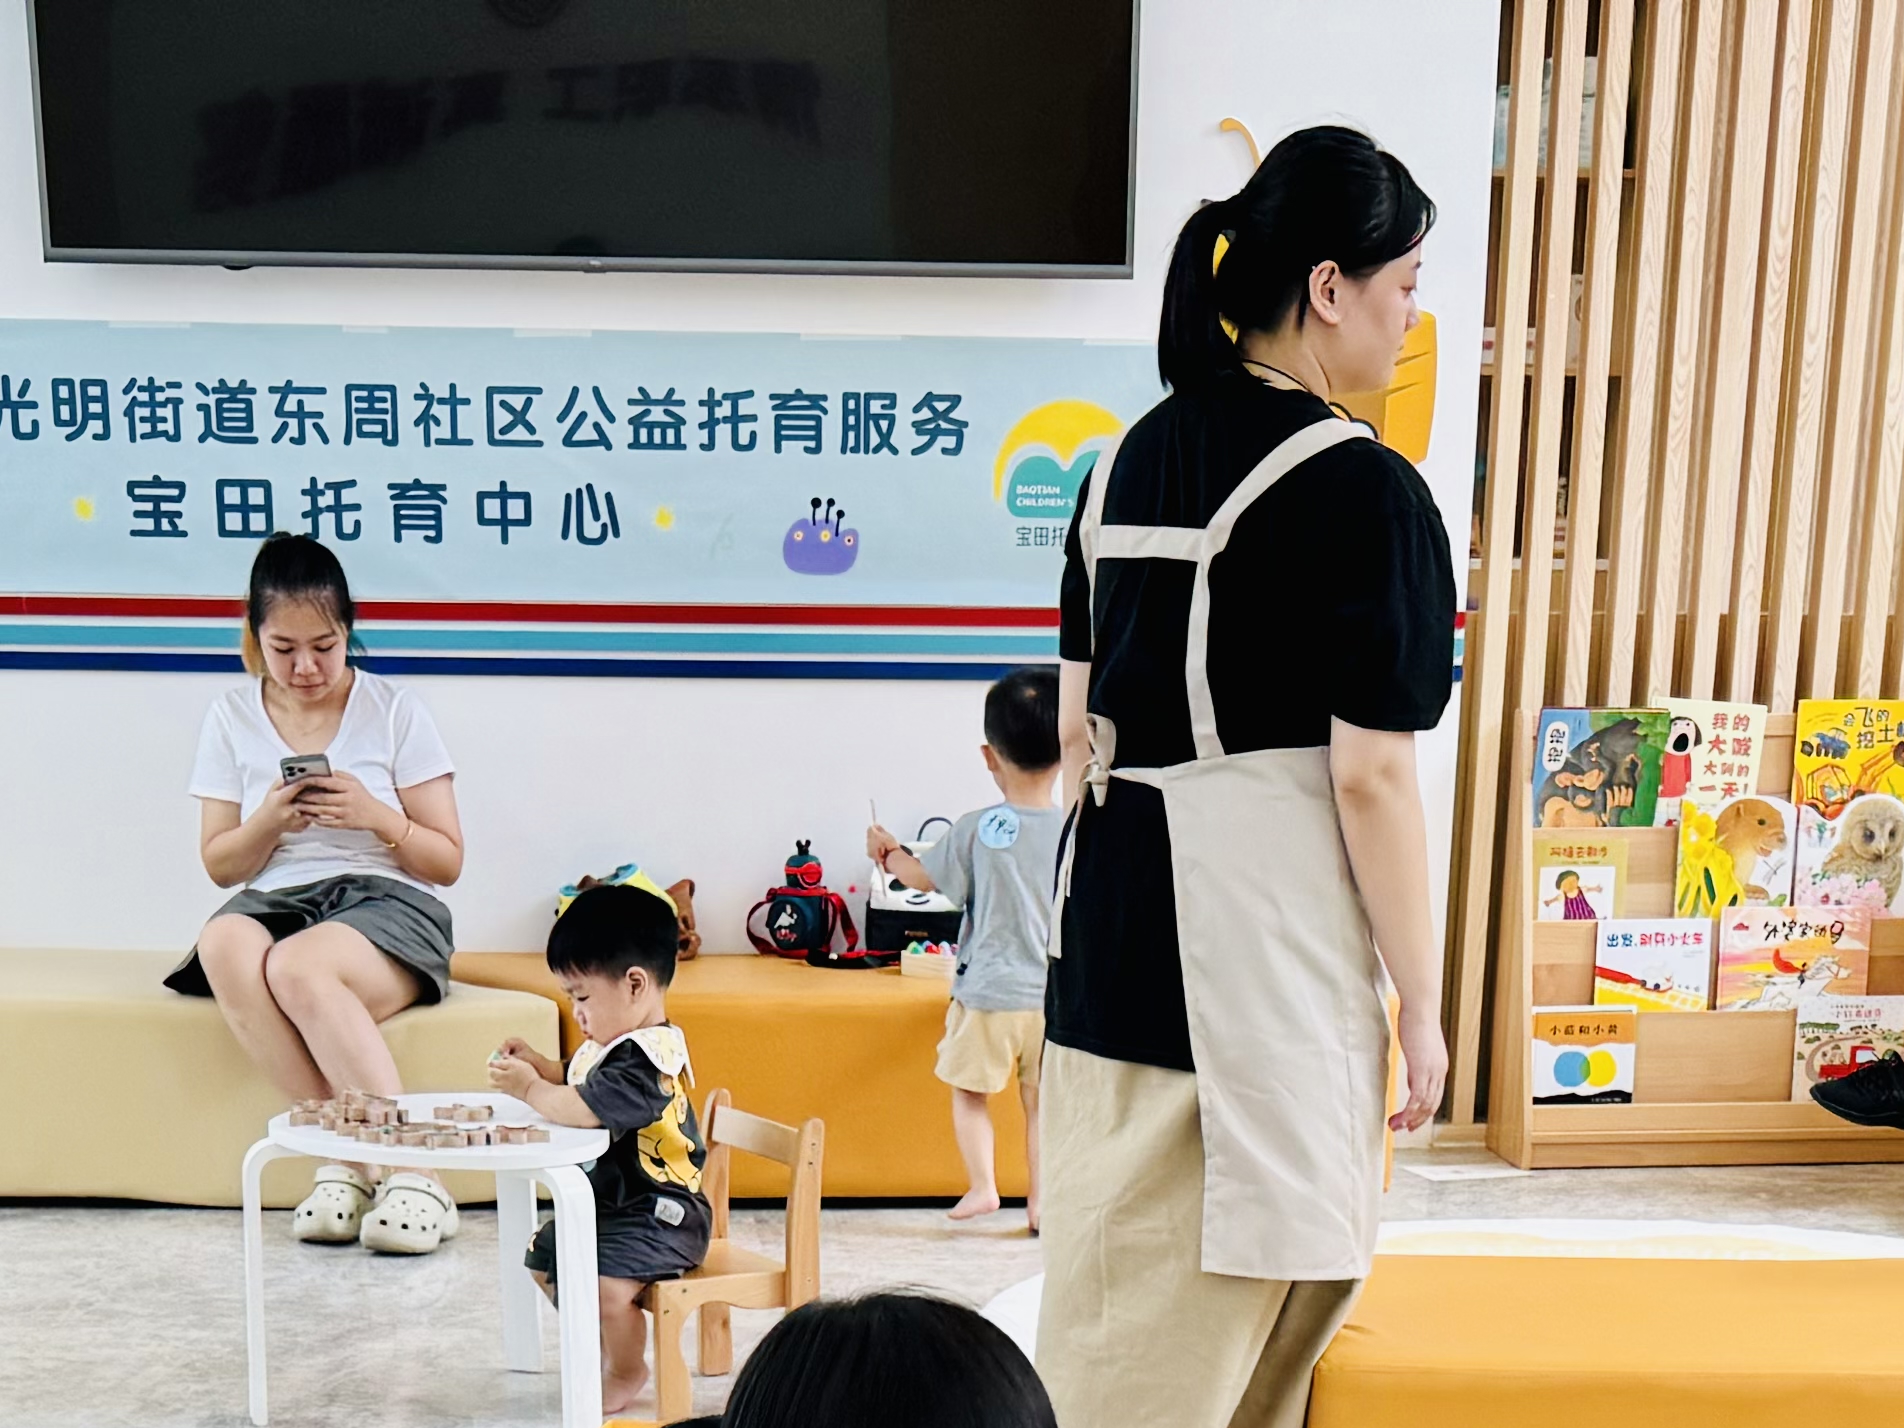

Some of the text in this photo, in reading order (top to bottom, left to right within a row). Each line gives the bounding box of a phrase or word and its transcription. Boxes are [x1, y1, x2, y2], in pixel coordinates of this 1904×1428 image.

[126, 474, 622, 546] 宝田托育中心
[1712, 712, 1751, 732] 我的
